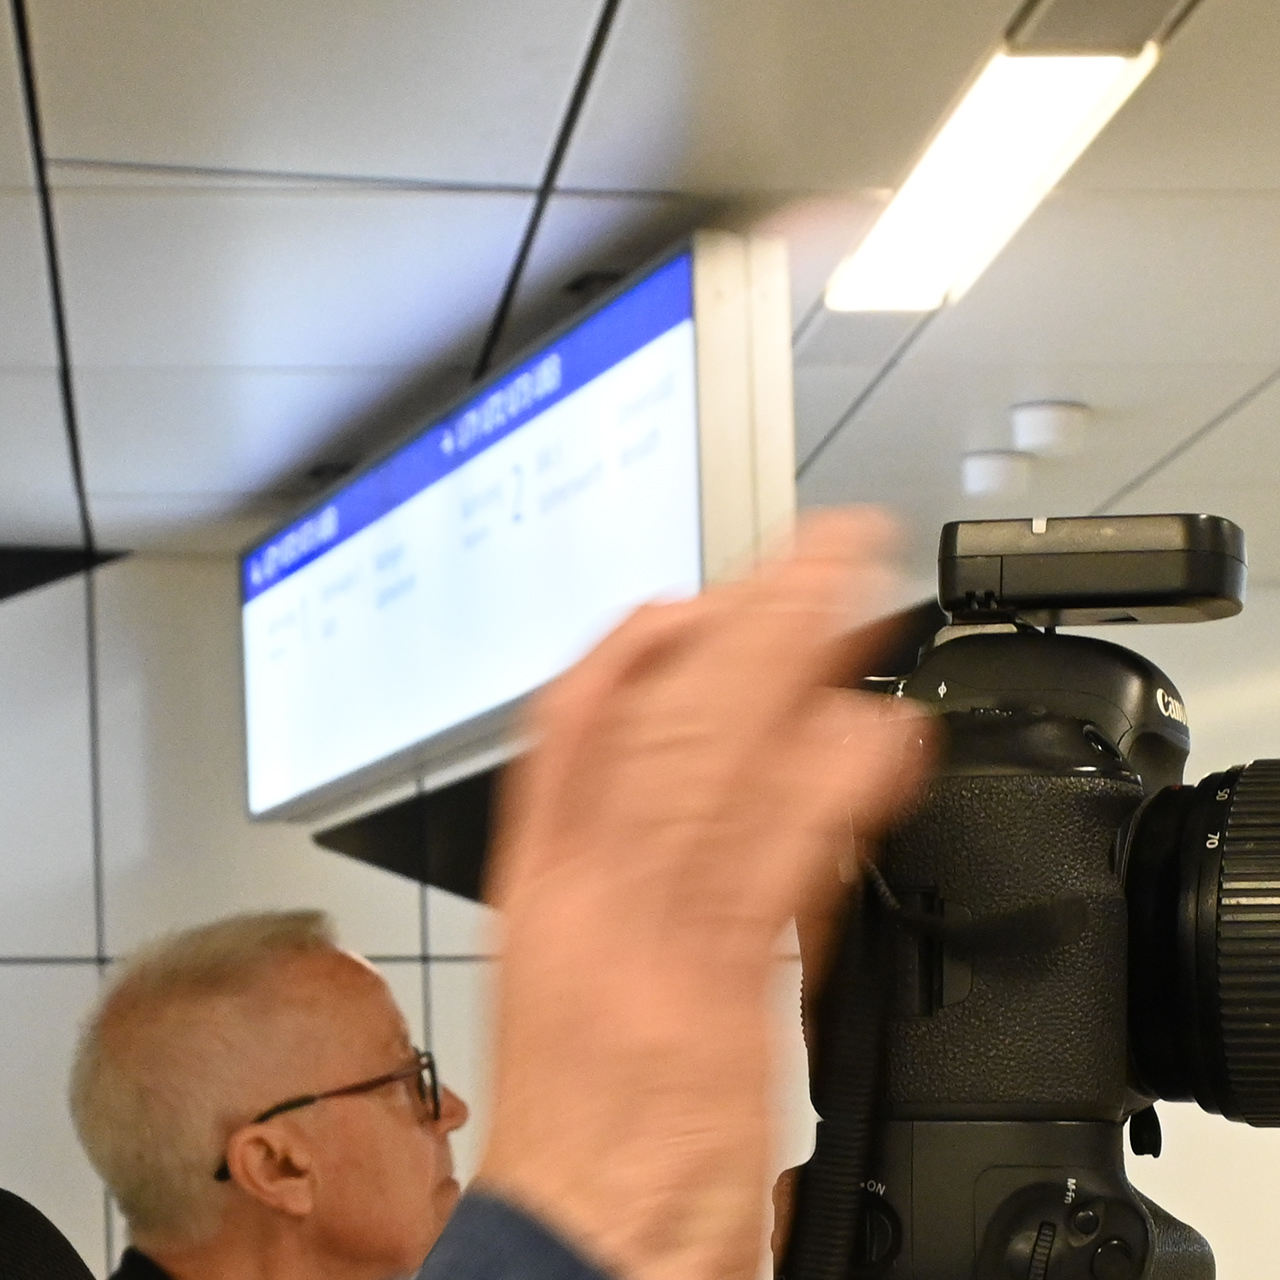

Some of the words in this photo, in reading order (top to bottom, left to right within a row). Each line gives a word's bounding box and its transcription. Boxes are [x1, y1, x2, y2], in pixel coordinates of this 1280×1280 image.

[1216, 788, 1230, 801] 50
[1206, 831, 1220, 849] 70
[867, 1180, 886, 1196] ON
